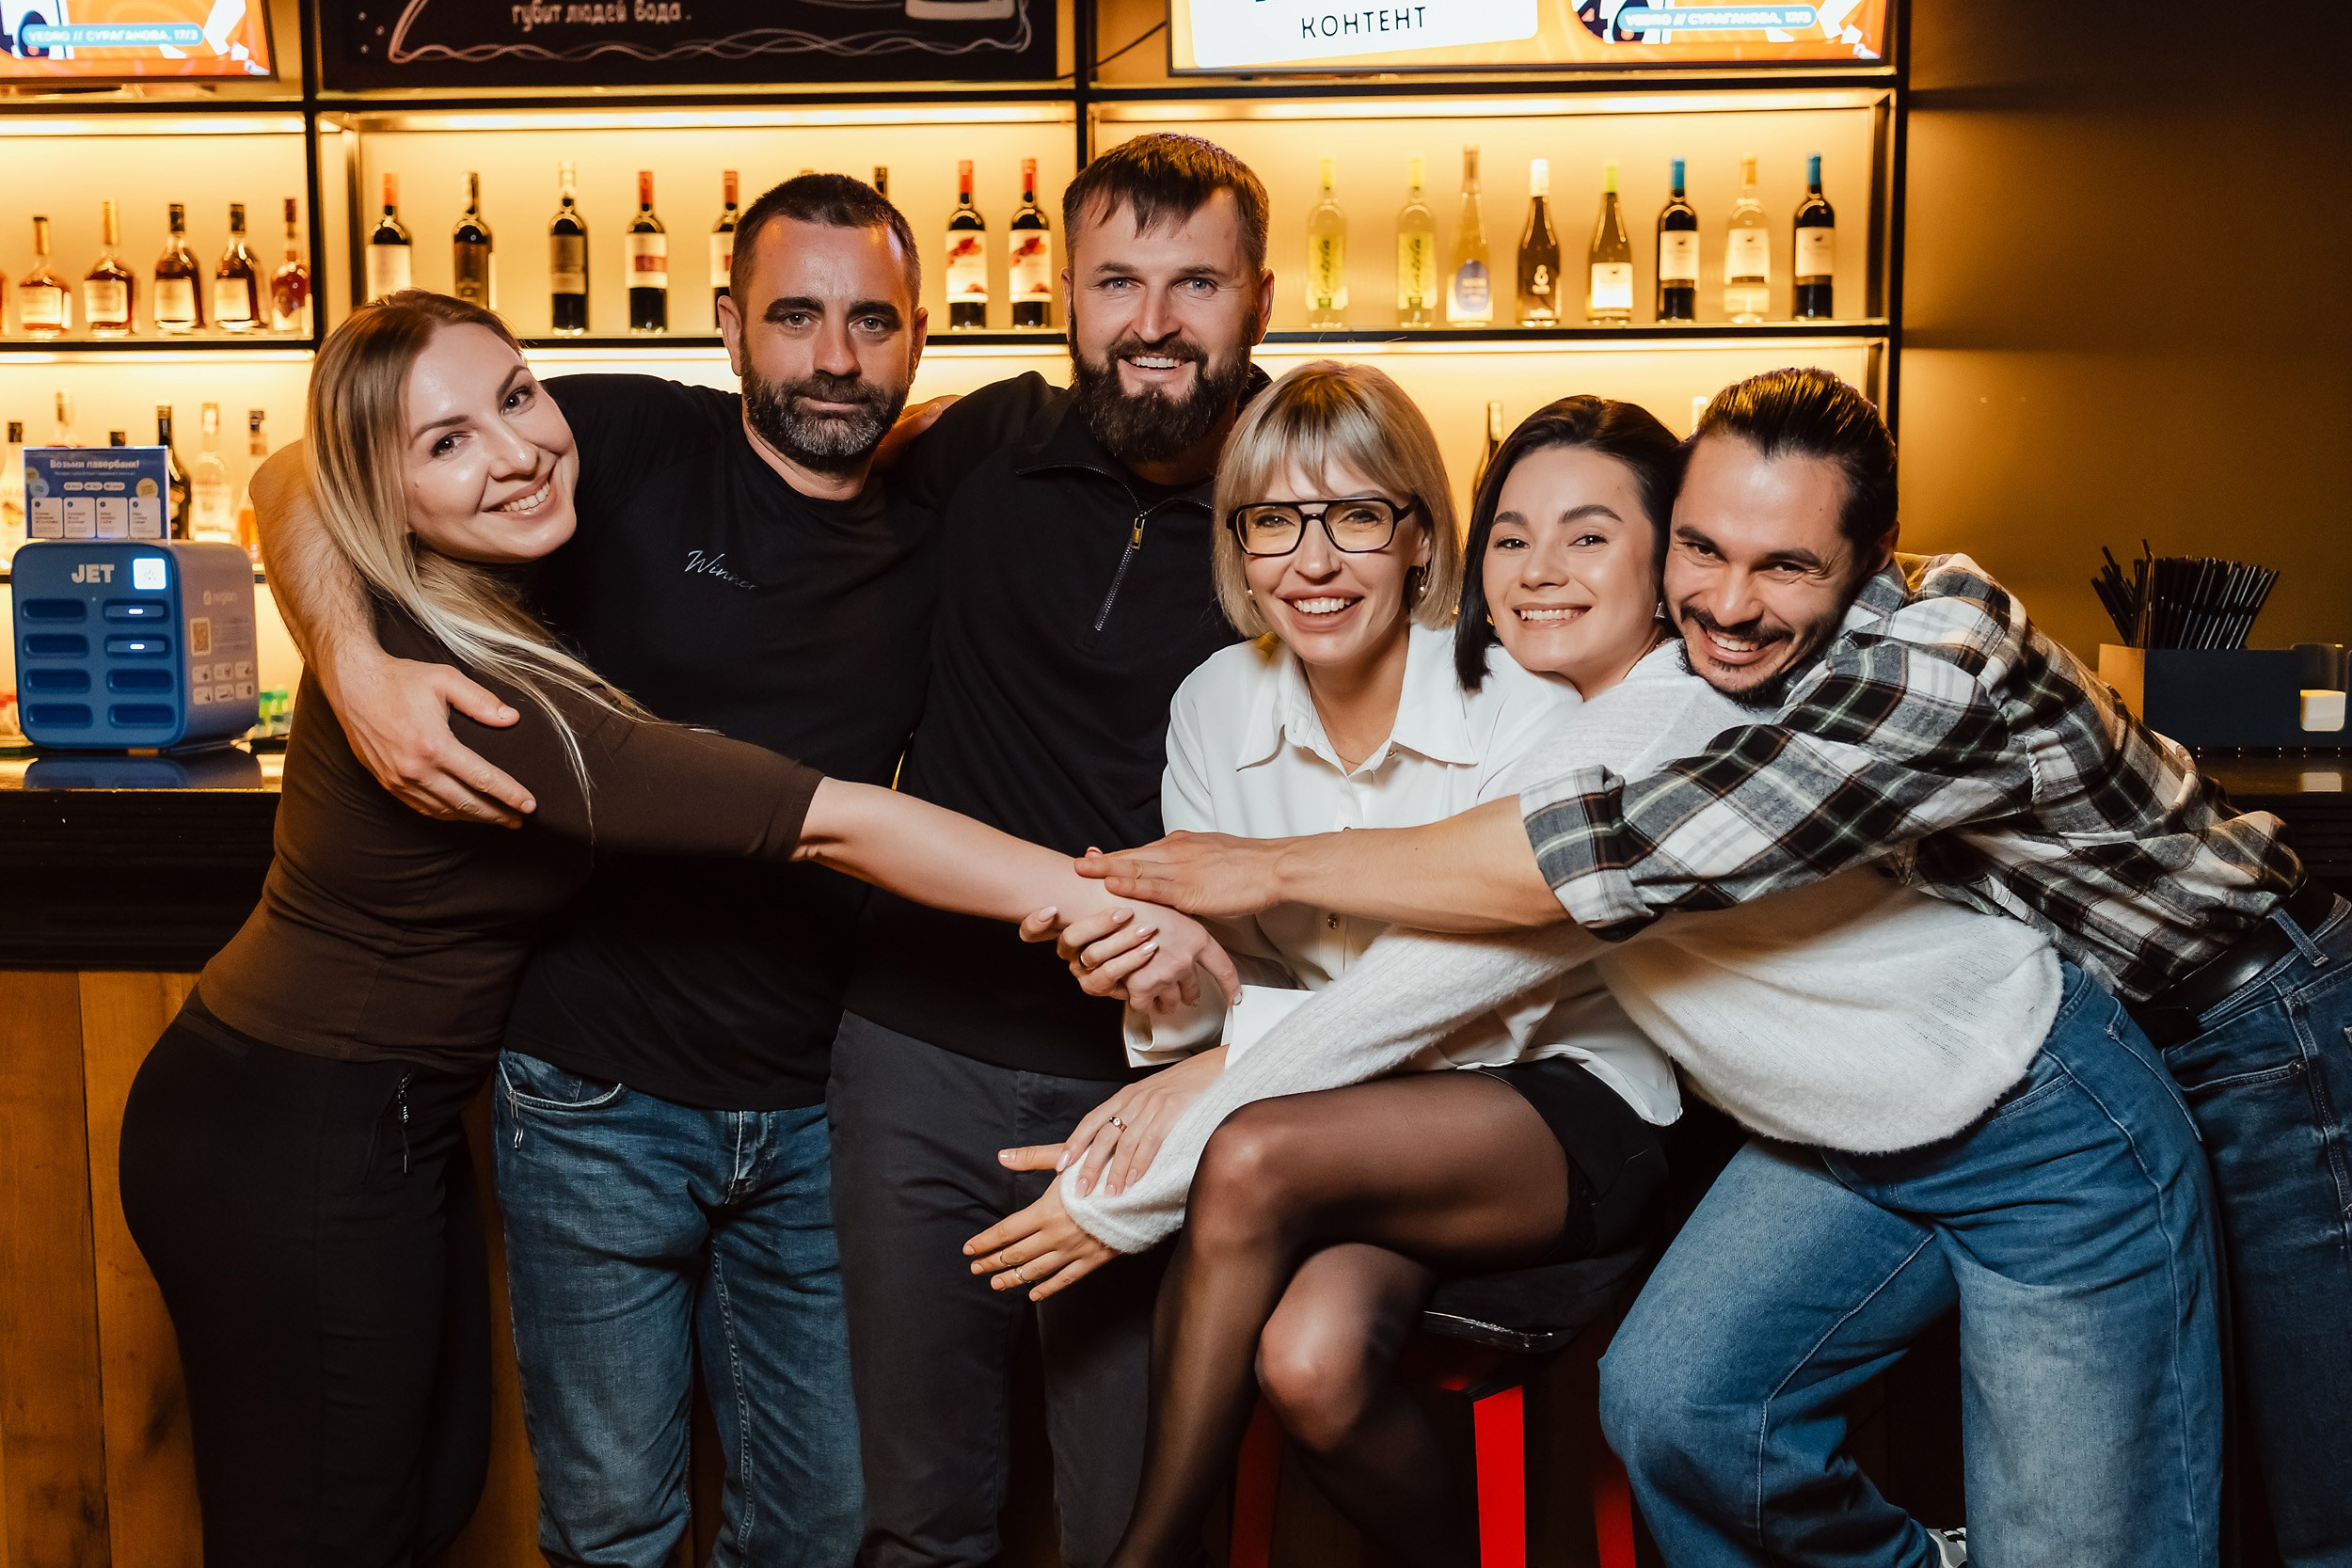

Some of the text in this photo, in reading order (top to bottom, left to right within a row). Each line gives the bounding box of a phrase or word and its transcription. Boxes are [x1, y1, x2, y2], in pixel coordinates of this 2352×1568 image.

[511, 0, 563, 32] губит
[565, 0, 628, 25] людей
[1301, 7, 1427, 40] КОНТЕНТ
[27, 29, 71, 42] VEDRO
[50, 459, 85, 469] Возьми
[71, 563, 115, 584] JET
[684, 549, 757, 590] Winner
